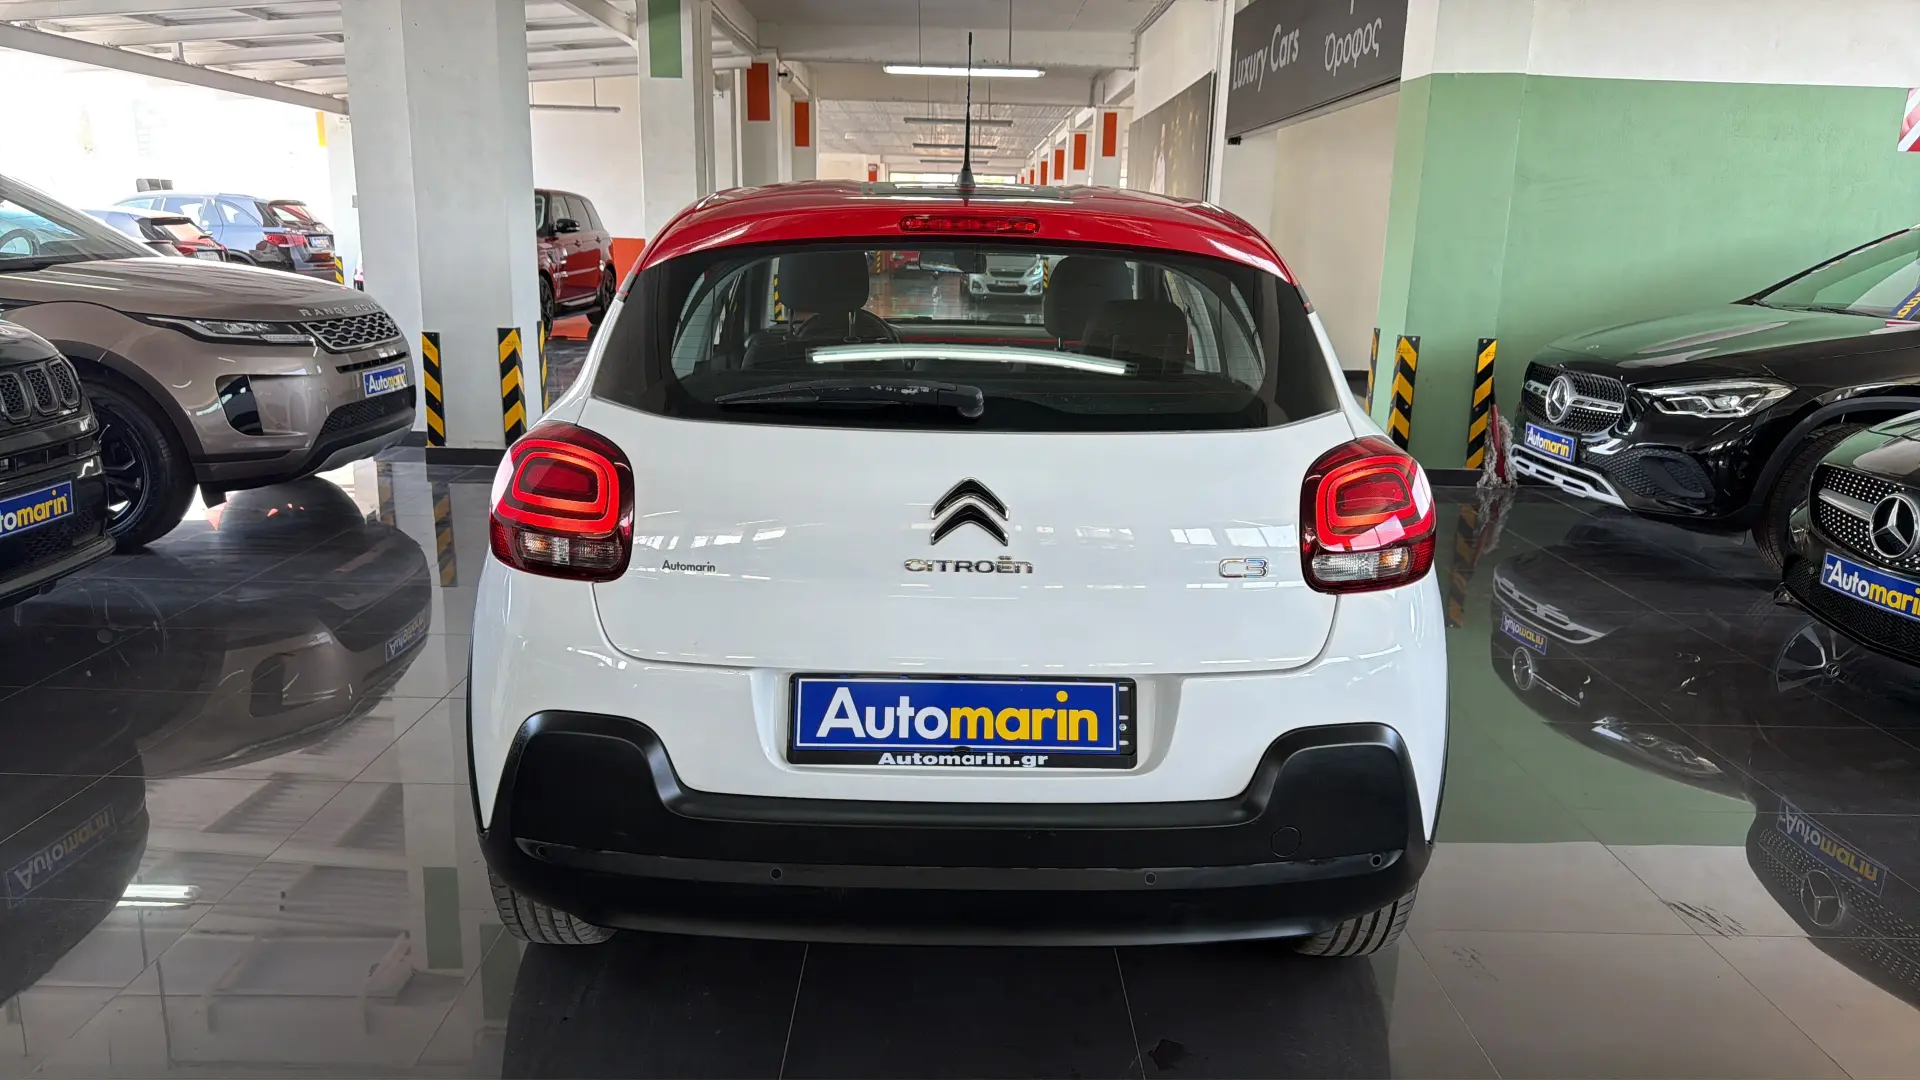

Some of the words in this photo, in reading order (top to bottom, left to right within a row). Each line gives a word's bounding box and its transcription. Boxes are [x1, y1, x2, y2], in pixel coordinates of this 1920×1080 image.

[1232, 46, 1268, 92] Luxury
[1271, 24, 1299, 72] Cars
[299, 306, 349, 317] RANGE
[1527, 427, 1570, 457] Automarin
[662, 559, 716, 573] Automarin
[1219, 556, 1269, 578] C3
[816, 686, 1098, 742] Automarin
[878, 752, 1049, 768] Automarin.gr
